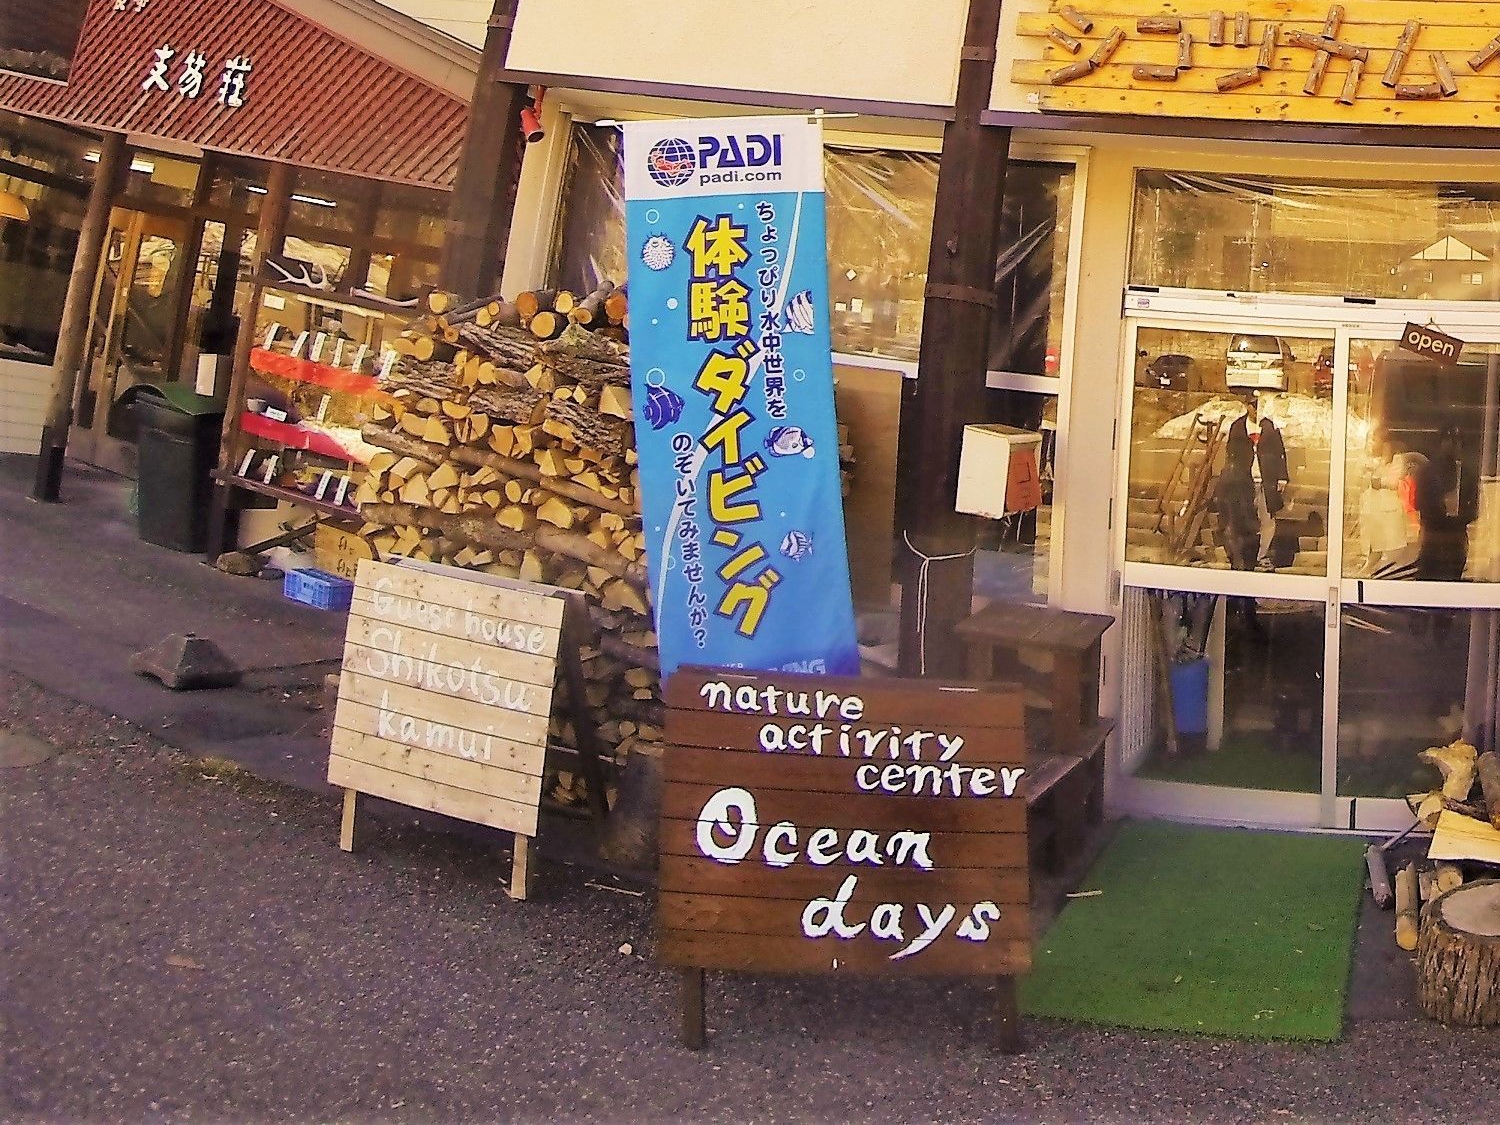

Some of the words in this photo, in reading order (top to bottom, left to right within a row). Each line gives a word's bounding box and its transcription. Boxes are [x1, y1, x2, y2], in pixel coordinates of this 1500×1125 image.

[699, 134, 782, 169] PADI
[699, 170, 782, 186] padi.com
[755, 201, 787, 418] ちょっぴり水中世界を
[1408, 331, 1455, 357] open
[684, 213, 783, 639] 体験ダイビング
[463, 599, 547, 654] house
[366, 627, 533, 712] Shikotsu
[699, 680, 865, 722] nature
[376, 689, 495, 762] kamui
[856, 761, 1025, 797] center
[695, 786, 934, 870] Ocean
[801, 874, 1001, 961] days
